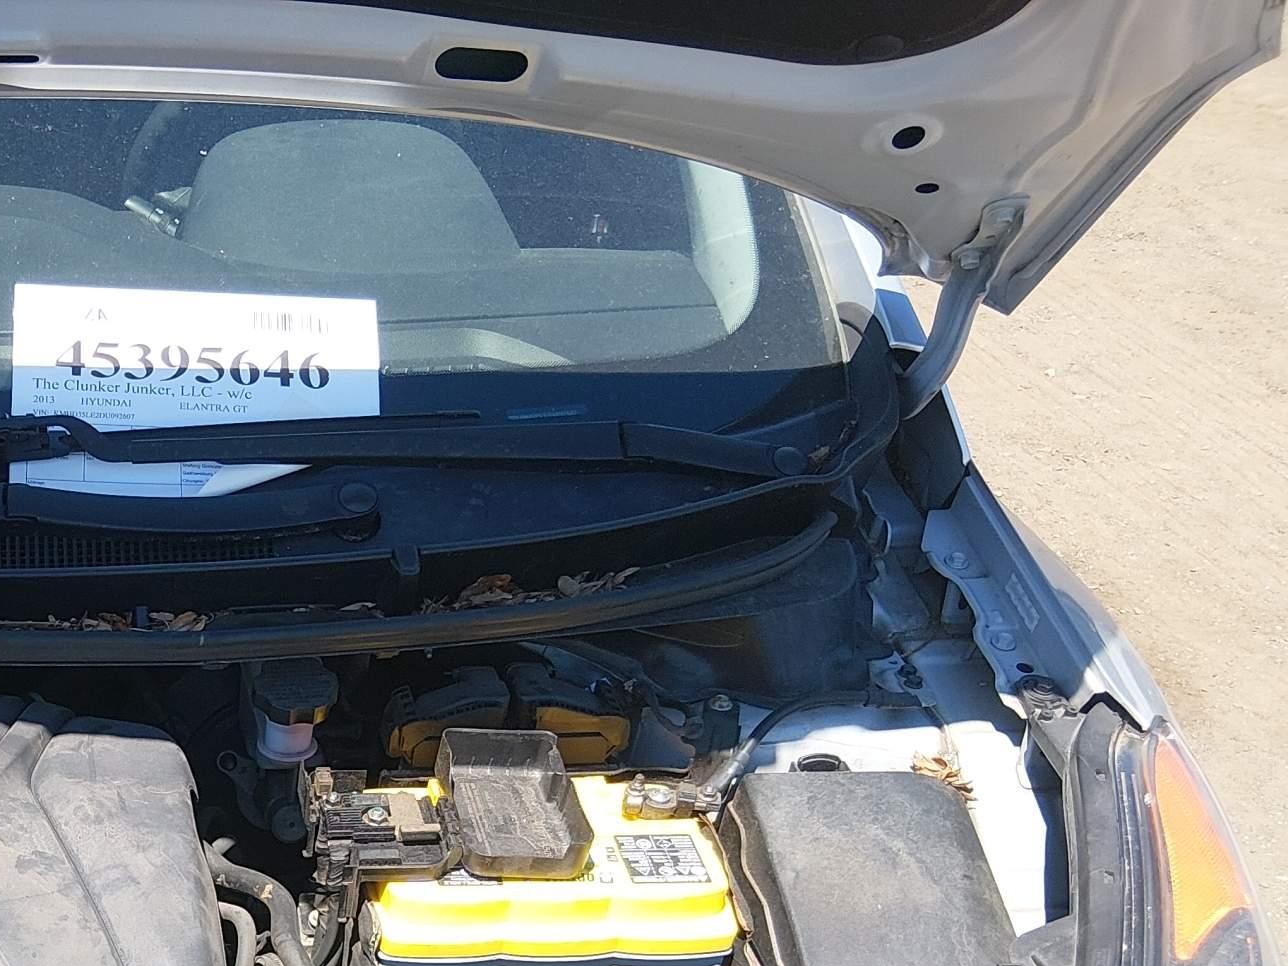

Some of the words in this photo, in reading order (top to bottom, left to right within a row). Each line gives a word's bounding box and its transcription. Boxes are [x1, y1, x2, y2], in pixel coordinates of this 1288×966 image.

[56, 340, 330, 389] 45395646
[32, 378, 60, 390] The
[64, 379, 120, 393] Clunker
[124, 382, 175, 397] Junker,
[180, 385, 212, 398] LLC
[33, 394, 55, 404] 2013
[81, 397, 132, 407] HYUNDAI
[179, 402, 229, 412] ELANTRA
[233, 405, 248, 413] GT
